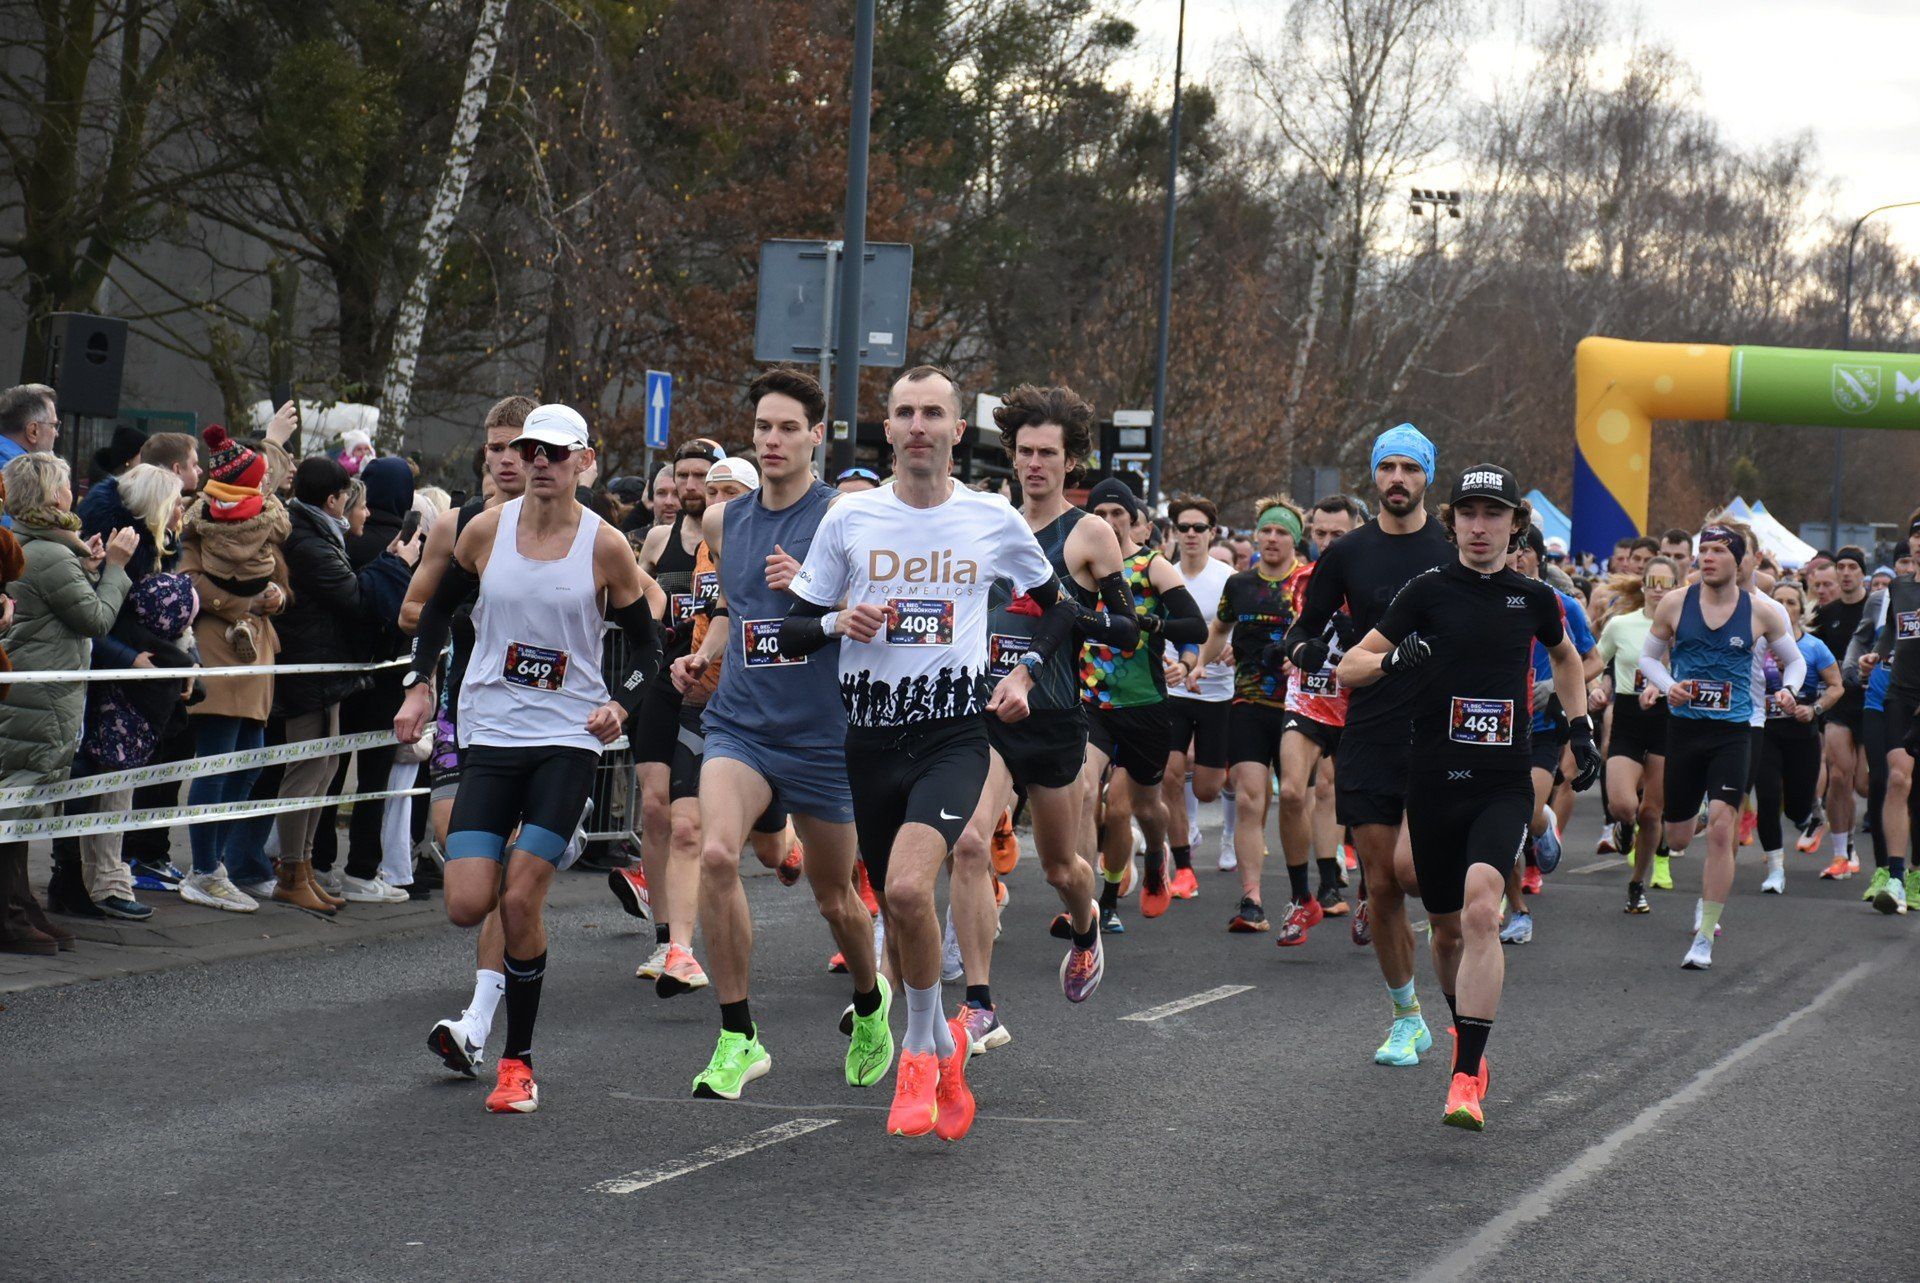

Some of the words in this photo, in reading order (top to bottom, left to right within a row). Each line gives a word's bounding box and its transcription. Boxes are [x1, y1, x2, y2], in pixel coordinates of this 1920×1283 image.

[1462, 471, 1504, 487] 226ERS
[868, 549, 979, 585] Delia
[700, 584, 719, 598] 792
[868, 585, 974, 597] COSMETICS
[900, 615, 939, 633] 408
[756, 636, 779, 654] 40
[1000, 651, 1020, 667] 44
[517, 660, 552, 679] 649
[1307, 675, 1328, 688] 827
[1700, 690, 1722, 702] 779
[1464, 715, 1499, 732] 463
